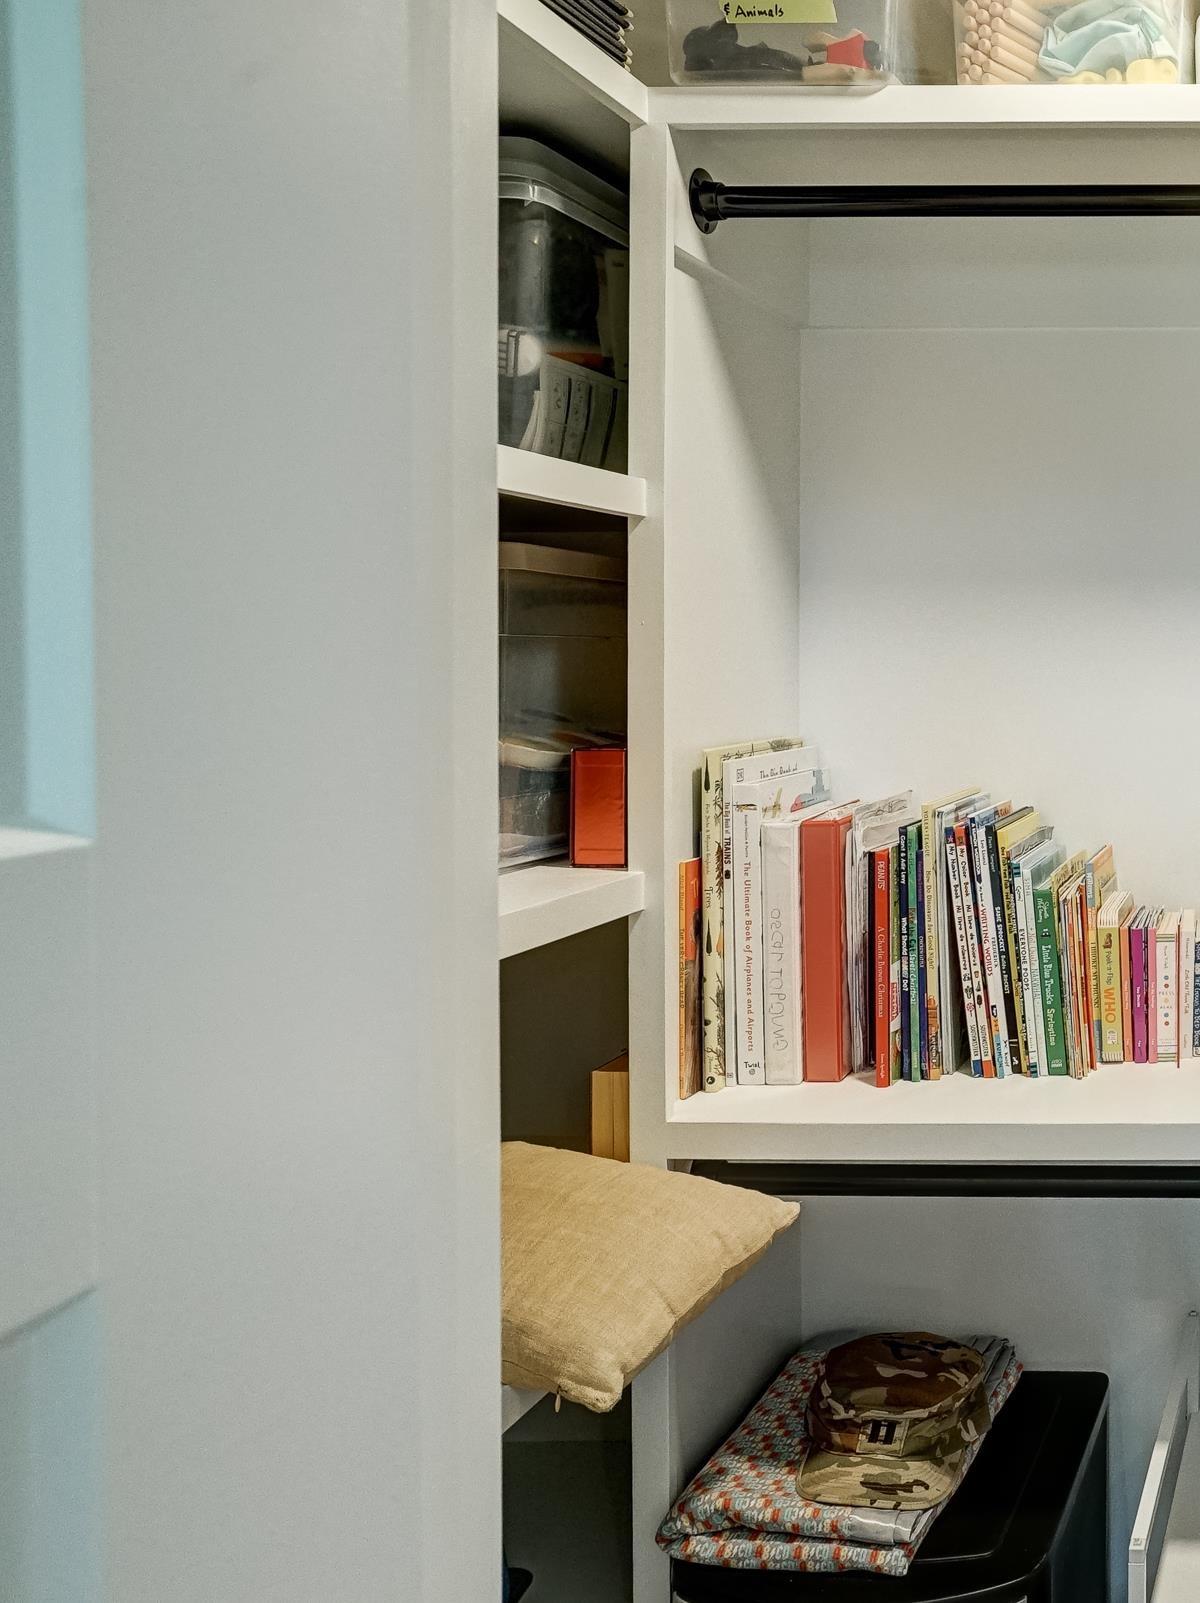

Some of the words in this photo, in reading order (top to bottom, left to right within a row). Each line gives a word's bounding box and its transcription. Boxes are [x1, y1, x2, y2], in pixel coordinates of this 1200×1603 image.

[735, 4, 784, 18] Animals
[948, 846, 956, 856] My
[958, 848, 966, 858] My
[744, 862, 752, 876] The
[950, 859, 958, 881] Number
[960, 861, 968, 878] Color
[705, 887, 713, 908] Trees
[926, 885, 932, 893] Do
[962, 882, 970, 897] Book
[744, 880, 752, 917] Ultimate
[956, 905, 962, 913] Mi
[966, 904, 972, 912] Mi
[959, 934, 965, 942] de
[969, 933, 975, 941] de
[980, 909, 990, 944] WRITING
[985, 947, 993, 977] WORDS
[744, 944, 752, 954] of
[1019, 929, 1028, 965] EVERYONE
[1042, 945, 1052, 963] Little
[997, 924, 1006, 952] SPROCKET
[1002, 974, 1010, 994] ROCKET
[744, 956, 753, 996] Airplanes
[1044, 964, 1053, 979] Blue
[1092, 972, 1098, 982] MY
[878, 984, 886, 1018] Christmas
[1045, 979, 1054, 1005] Truck's
[1103, 987, 1116, 1024] WHO
[745, 1017, 754, 1052] Airports
[1046, 1008, 1056, 1046] Springtime
[980, 1024, 990, 1057] SOUTHWESTERN
[996, 1042, 1004, 1068] KUMON
